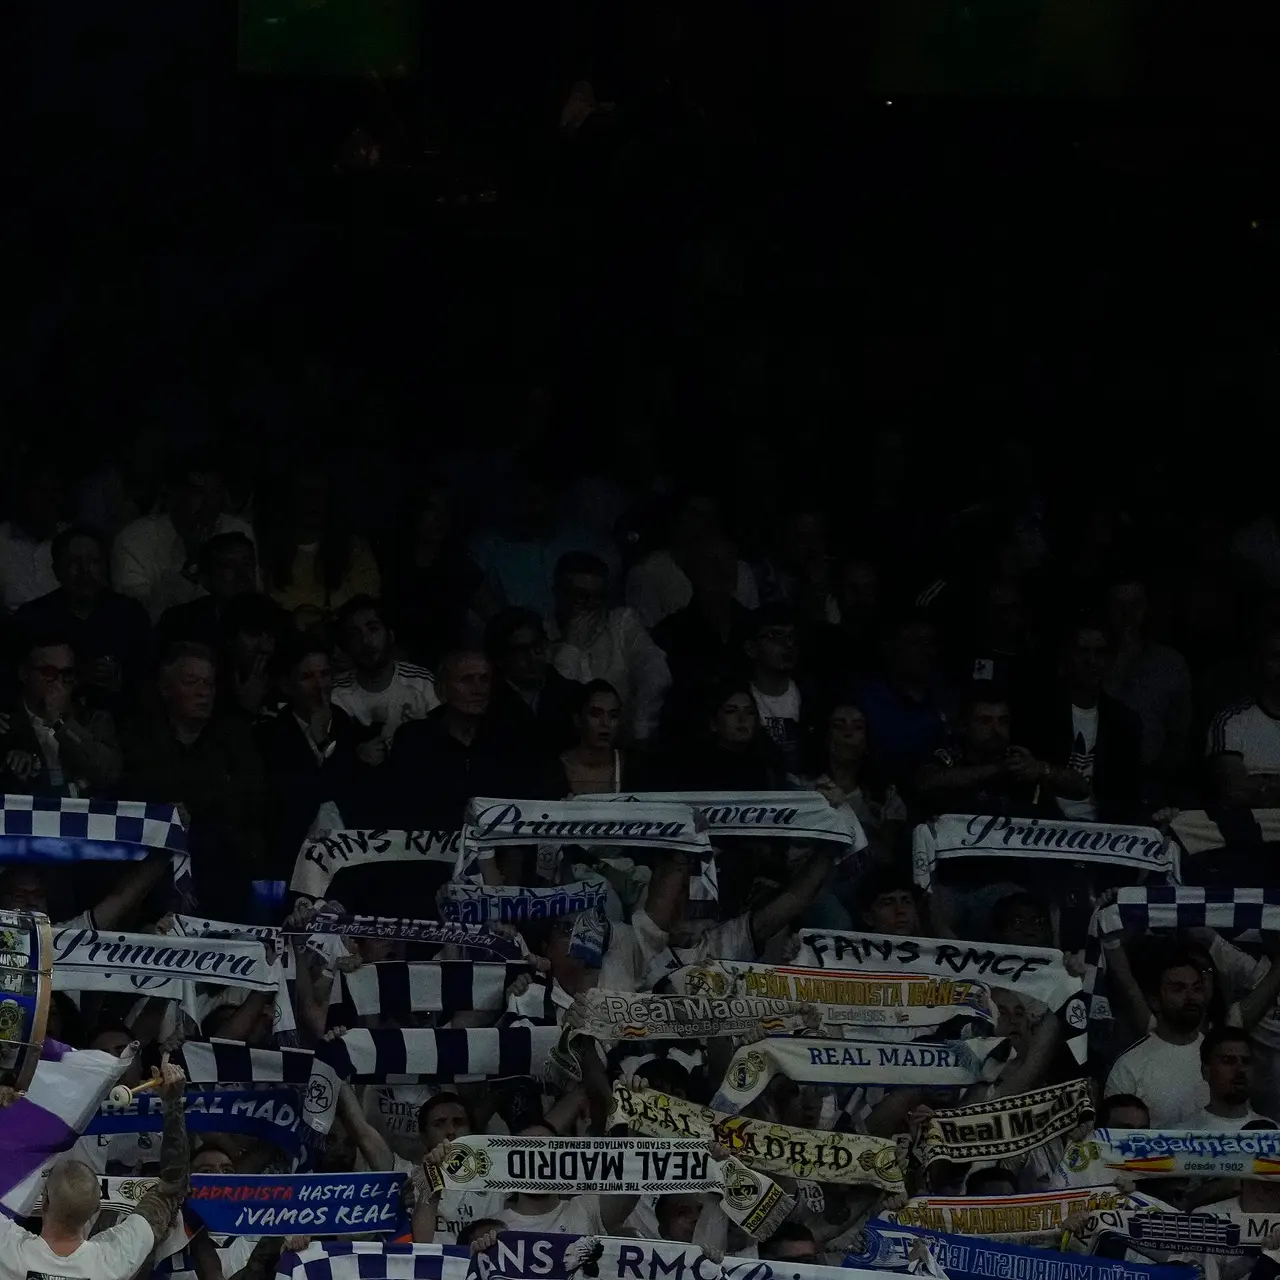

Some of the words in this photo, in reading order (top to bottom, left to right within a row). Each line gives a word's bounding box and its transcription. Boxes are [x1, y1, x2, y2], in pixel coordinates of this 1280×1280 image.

[477, 802, 685, 838] Primavera
[962, 812, 1167, 861] Primavera
[53, 926, 257, 978] Primavera
[803, 935, 920, 967] FANS
[936, 945, 1053, 981] RMCF
[608, 996, 675, 1025] Real
[680, 992, 793, 1022] Madrid
[809, 1047, 873, 1067] REAL
[593, 1140, 634, 1150] SANTIAGO
[507, 1150, 624, 1180] MADRID
[635, 1150, 710, 1180] REAL
[297, 1183, 355, 1201] HASTA
[360, 1181, 386, 1199] EL
[235, 1206, 326, 1227] ¡VAMOS
